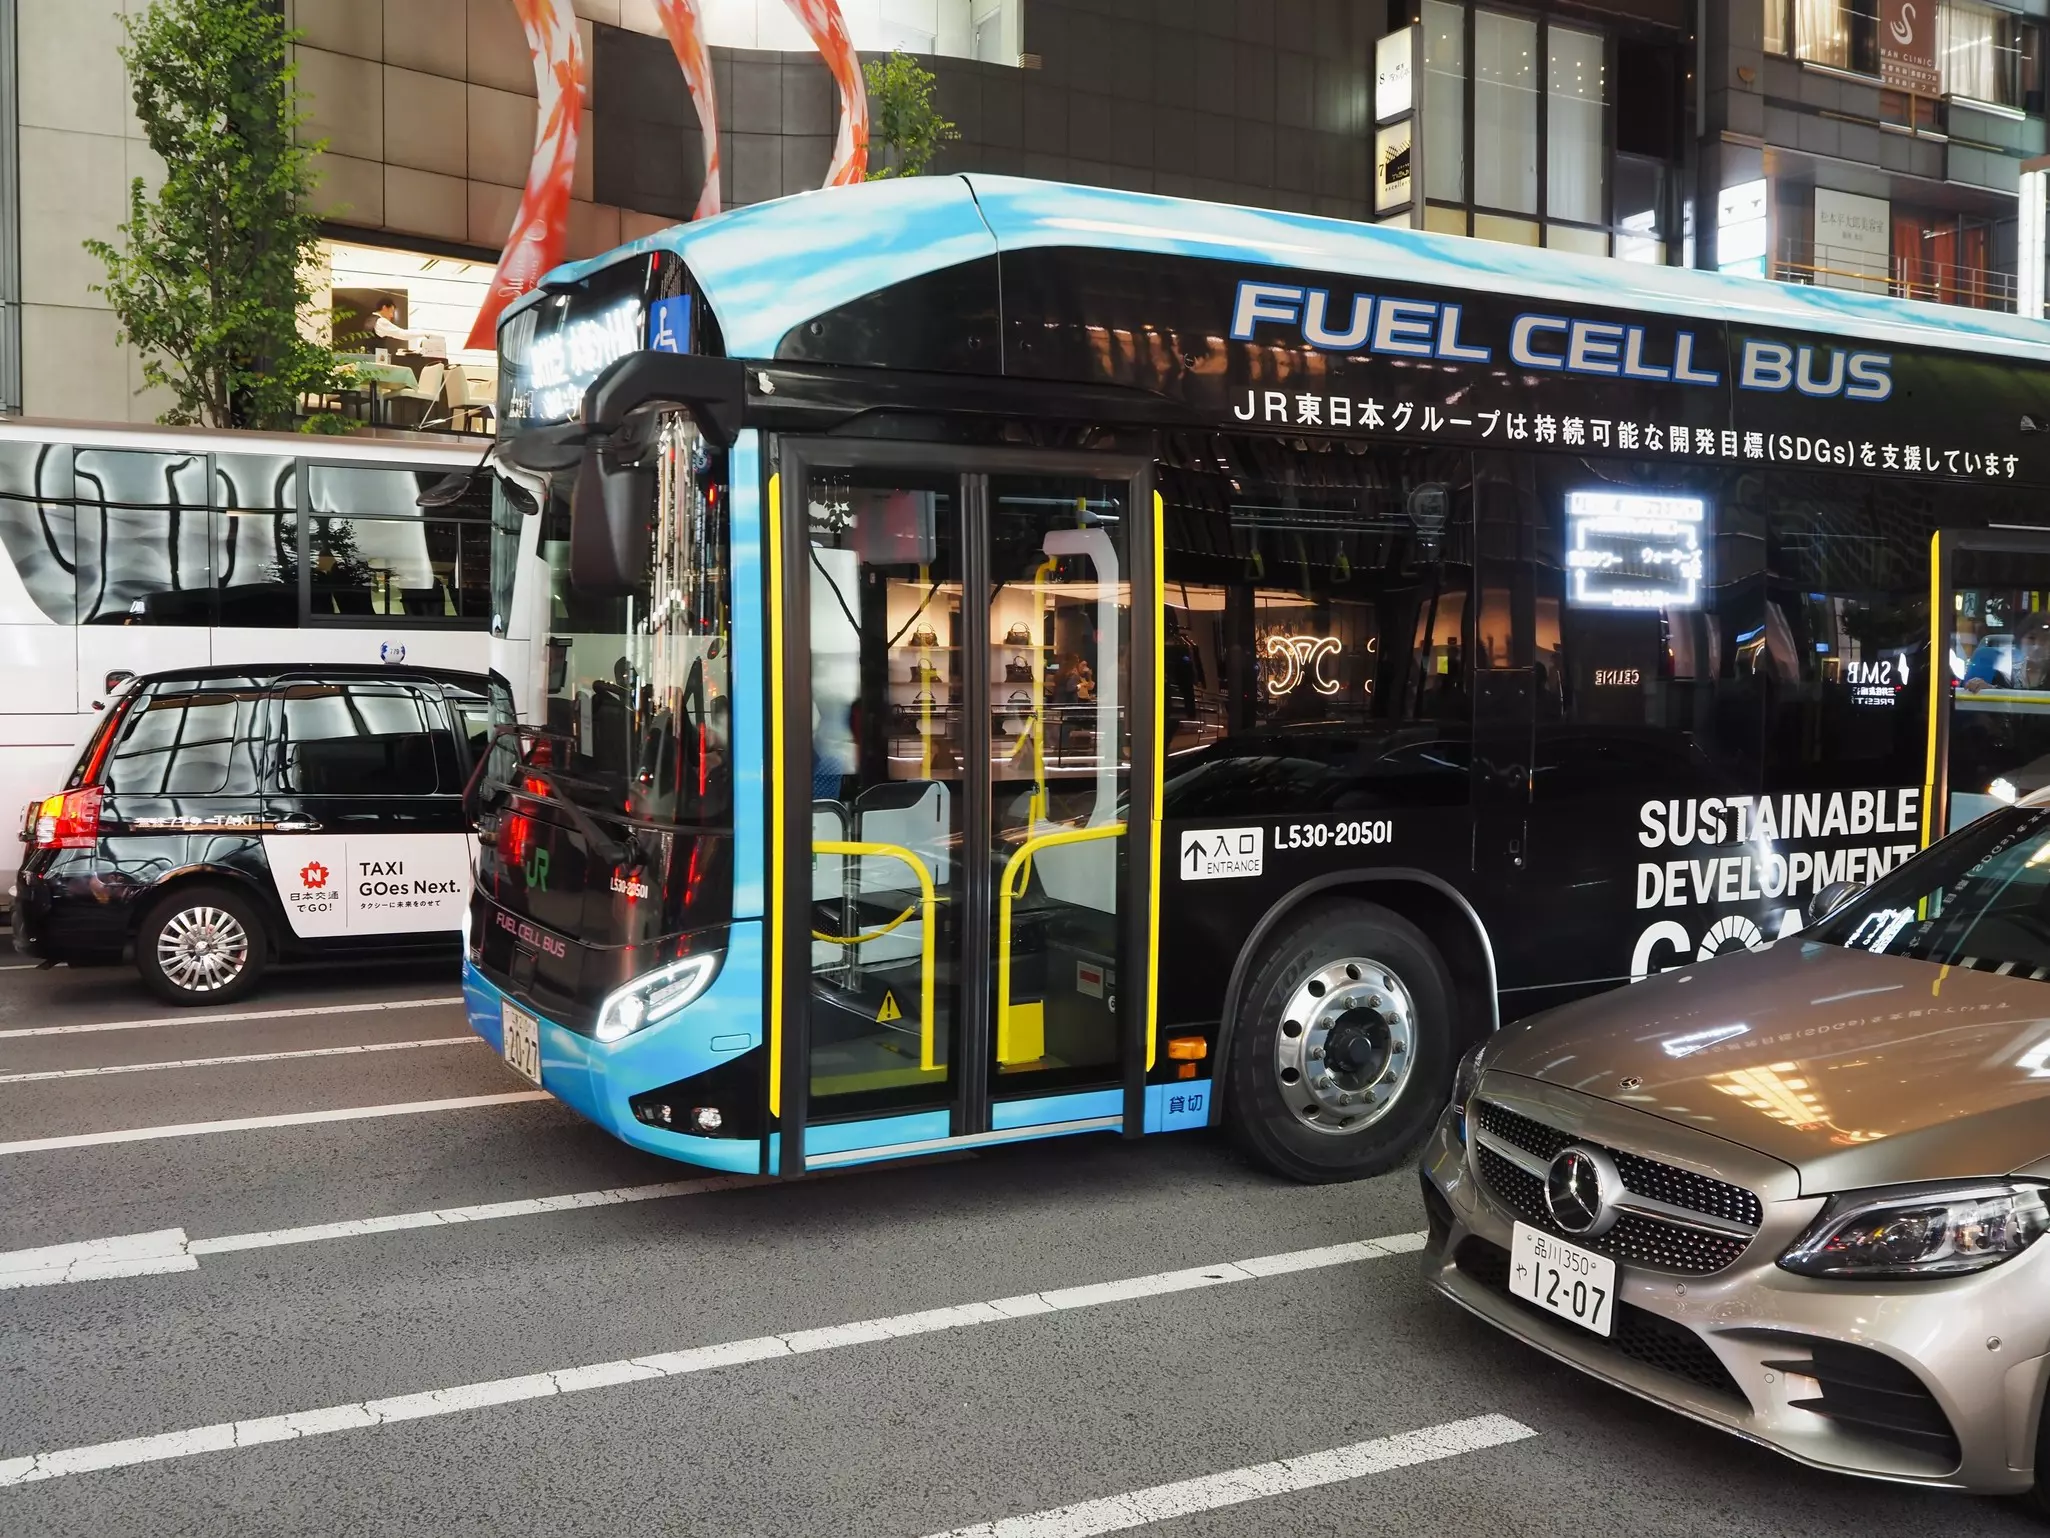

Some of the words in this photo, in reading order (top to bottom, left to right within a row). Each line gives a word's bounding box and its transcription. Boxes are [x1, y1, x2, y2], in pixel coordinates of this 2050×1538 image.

[1903, 54, 1933, 67] CLINIC
[1229, 280, 1492, 363] FUEL
[1509, 312, 1719, 386] CELL
[1739, 337, 1893, 401] BUS
[1233, 389, 2020, 480] JR東日本グループは持続可能な開発目標(SDGs)を支援しています
[213, 815, 253, 827] TAXI
[1637, 788, 1920, 848] SUSTAINABLE
[1213, 834, 1254, 858] 入口
[1274, 820, 1393, 850] L530-20501
[359, 861, 403, 876] TAXI
[526, 847, 549, 892] JR
[1207, 859, 1260, 875] ENTRANCE
[290, 890, 339, 901] 日本交通
[359, 881, 409, 897] GOes
[414, 879, 461, 895] Next.
[610, 876, 649, 899] L530-20501
[297, 903, 332, 913] でGO!
[360, 899, 441, 910] タクシーに未来をのせて
[496, 911, 518, 937] FUEL
[518, 923, 541, 947] CELL
[542, 936, 566, 959] BUS
[1169, 1094, 1203, 1115] 貸切
[1516, 1262, 1528, 1281] や
[1534, 1261, 1606, 1325] 12-07
